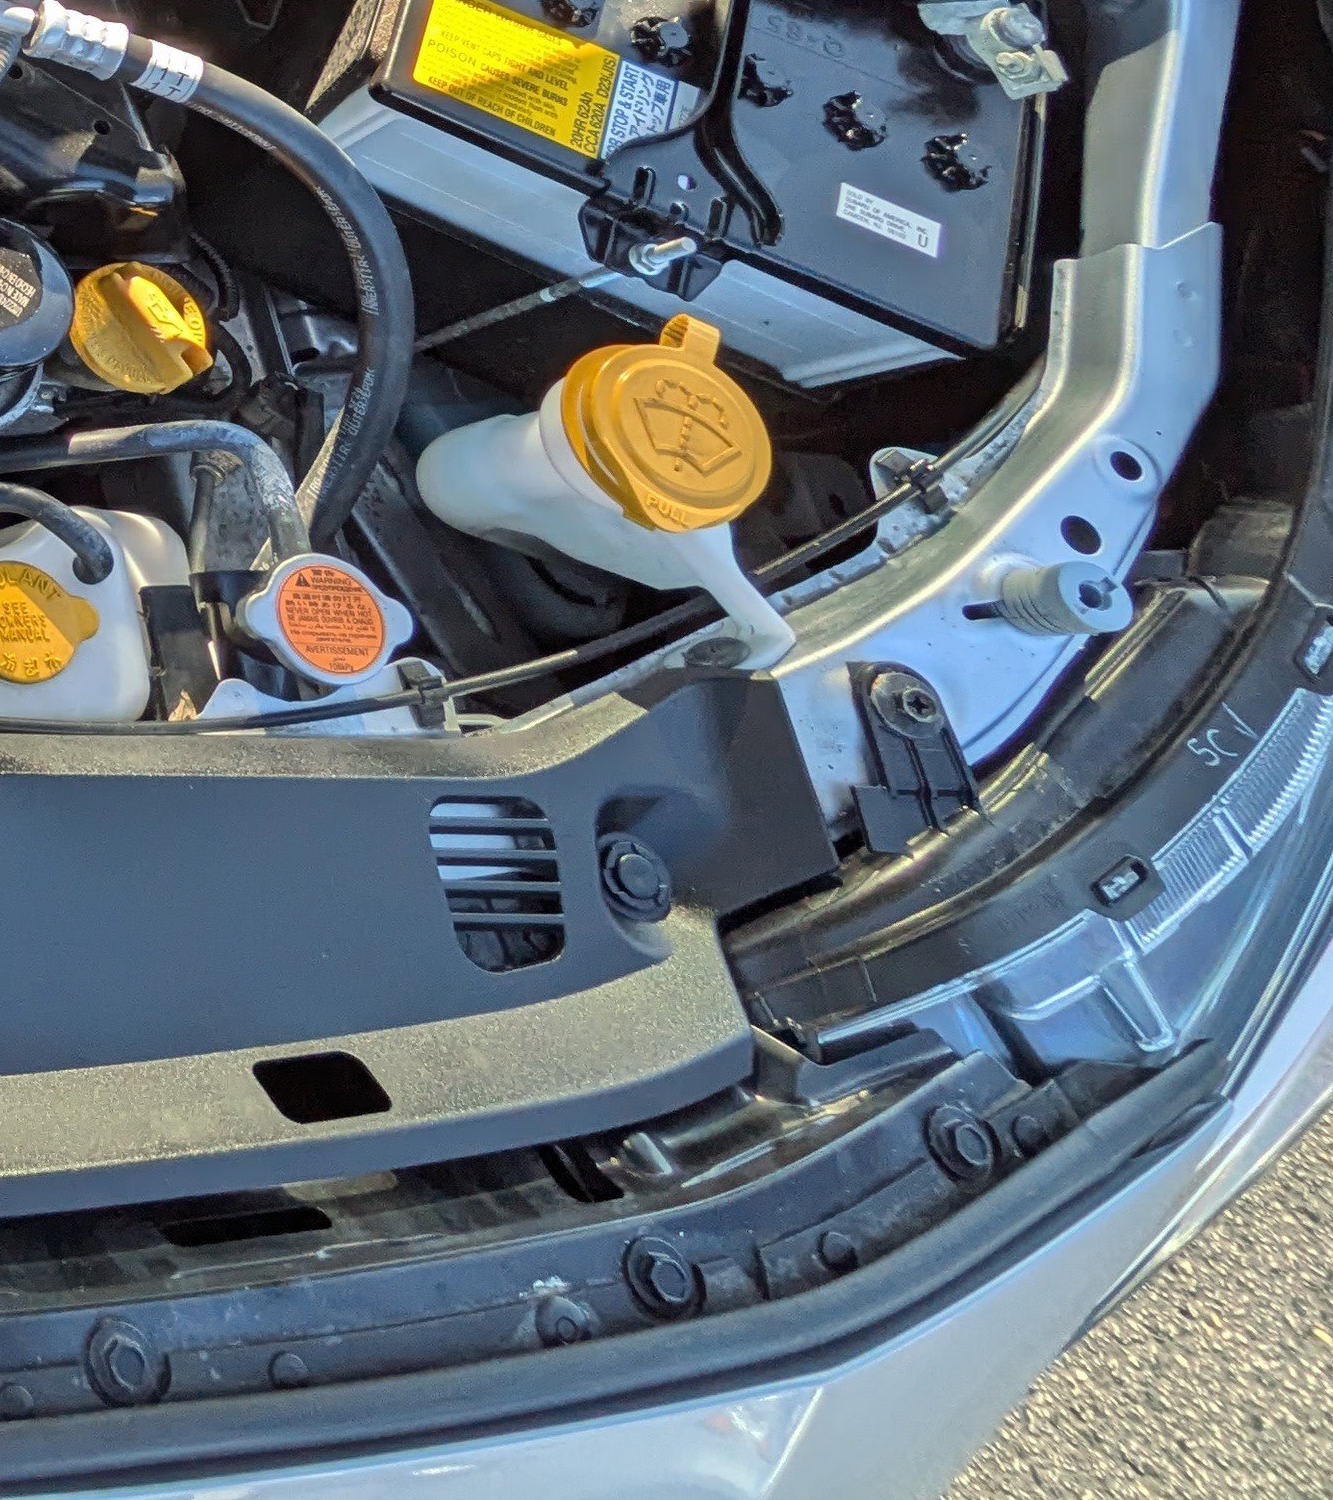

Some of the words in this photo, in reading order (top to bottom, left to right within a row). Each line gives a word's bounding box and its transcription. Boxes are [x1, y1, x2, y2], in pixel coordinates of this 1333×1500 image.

[426, 39, 478, 67] POISON
[511, 76, 540, 94] SEVERE
[541, 89, 569, 107] BURNS
[590, 54, 622, 99] D23(JIS)
[615, 65, 644, 100] START
[427, 75, 447, 89] KEEP
[448, 84, 465, 97] OUT
[465, 91, 477, 102] OF
[477, 97, 504, 114] REACH
[505, 108, 516, 119] OF
[516, 113, 557, 137] CHILDREN
[573, 90, 596, 119] 62Ah
[586, 101, 608, 129] 620A
[617, 98, 632, 110] &
[567, 118, 591, 148] 20HR
[607, 109, 633, 139] STOP
[580, 128, 603, 154] CCA
[915, 234, 930, 249] U
[644, 493, 690, 526] PULL
[311, 576, 351, 586] WARNING
[2, 601, 29, 615] SEE
[285, 607, 309, 615] NEVER
[312, 608, 330, 616] OPEN
[0, 628, 50, 643] MANUAL
[305, 645, 369, 656] AVERTISSEMENT
